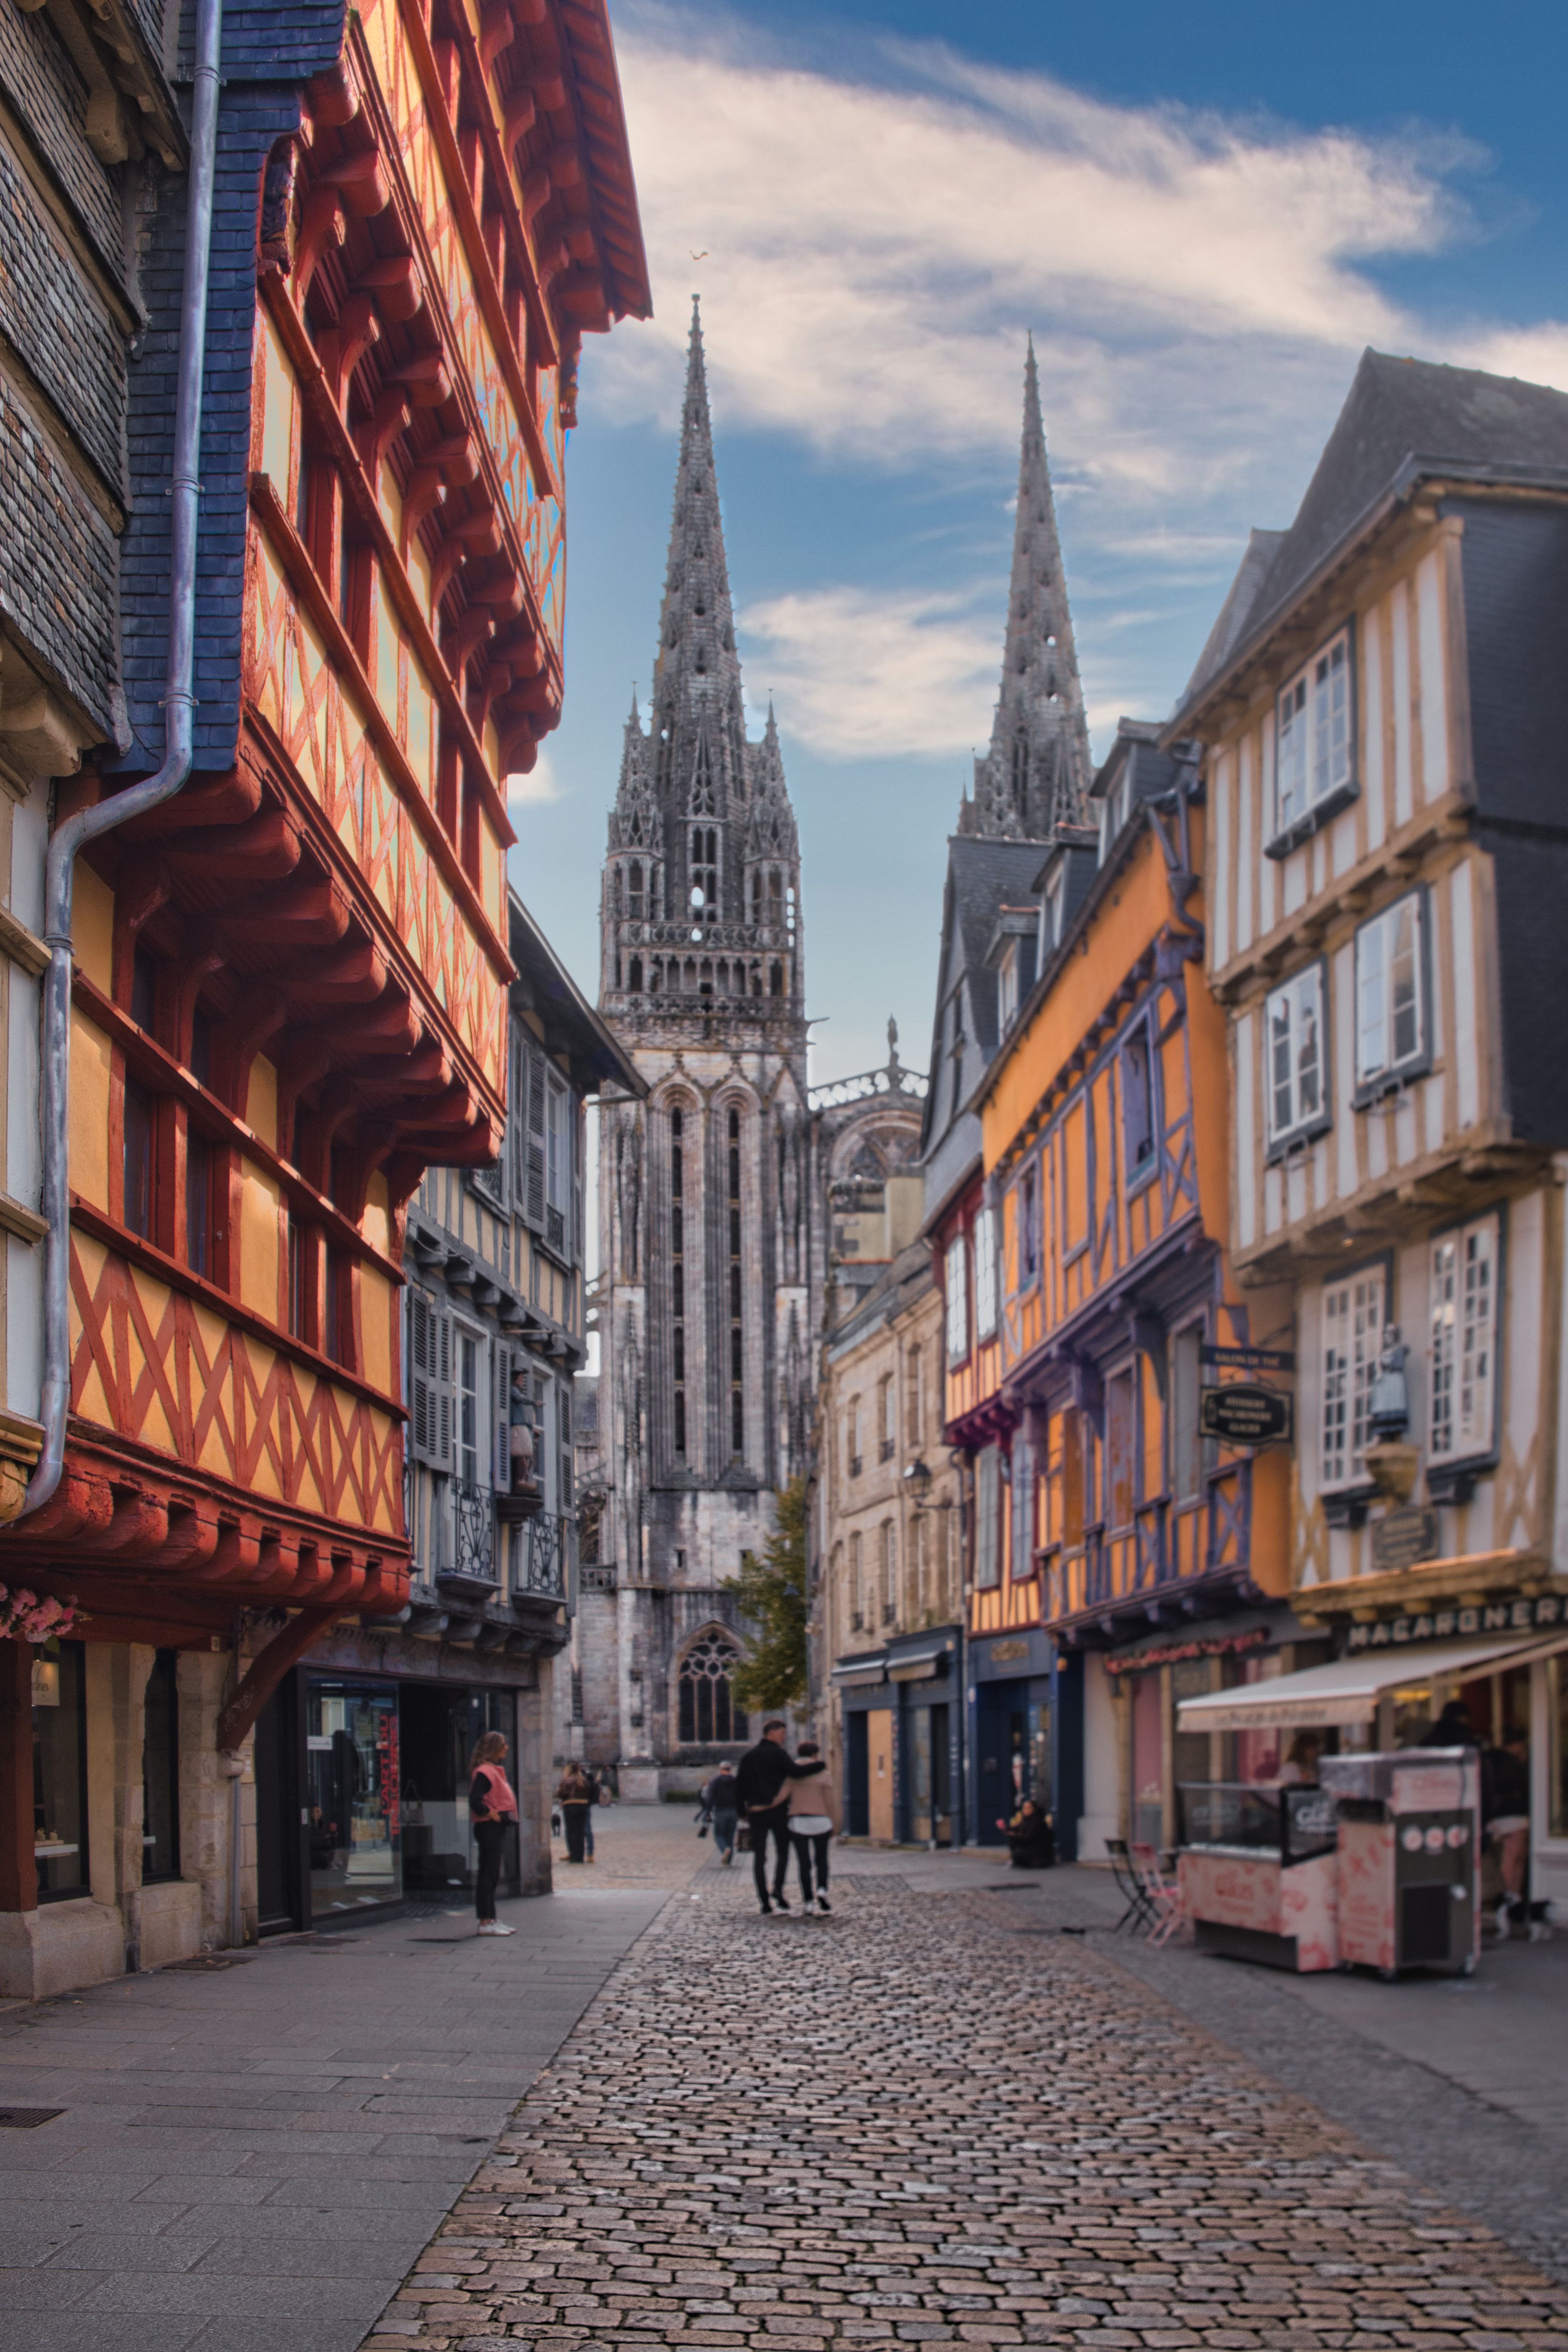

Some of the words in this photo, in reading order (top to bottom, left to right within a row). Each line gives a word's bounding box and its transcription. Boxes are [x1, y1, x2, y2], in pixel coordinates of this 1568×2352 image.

[1215, 1353, 1245, 1363] SALON
[1248, 1356, 1259, 1365] DE
[1349, 1598, 1568, 1647] MACARONER
[380, 1715, 389, 1749] DU
